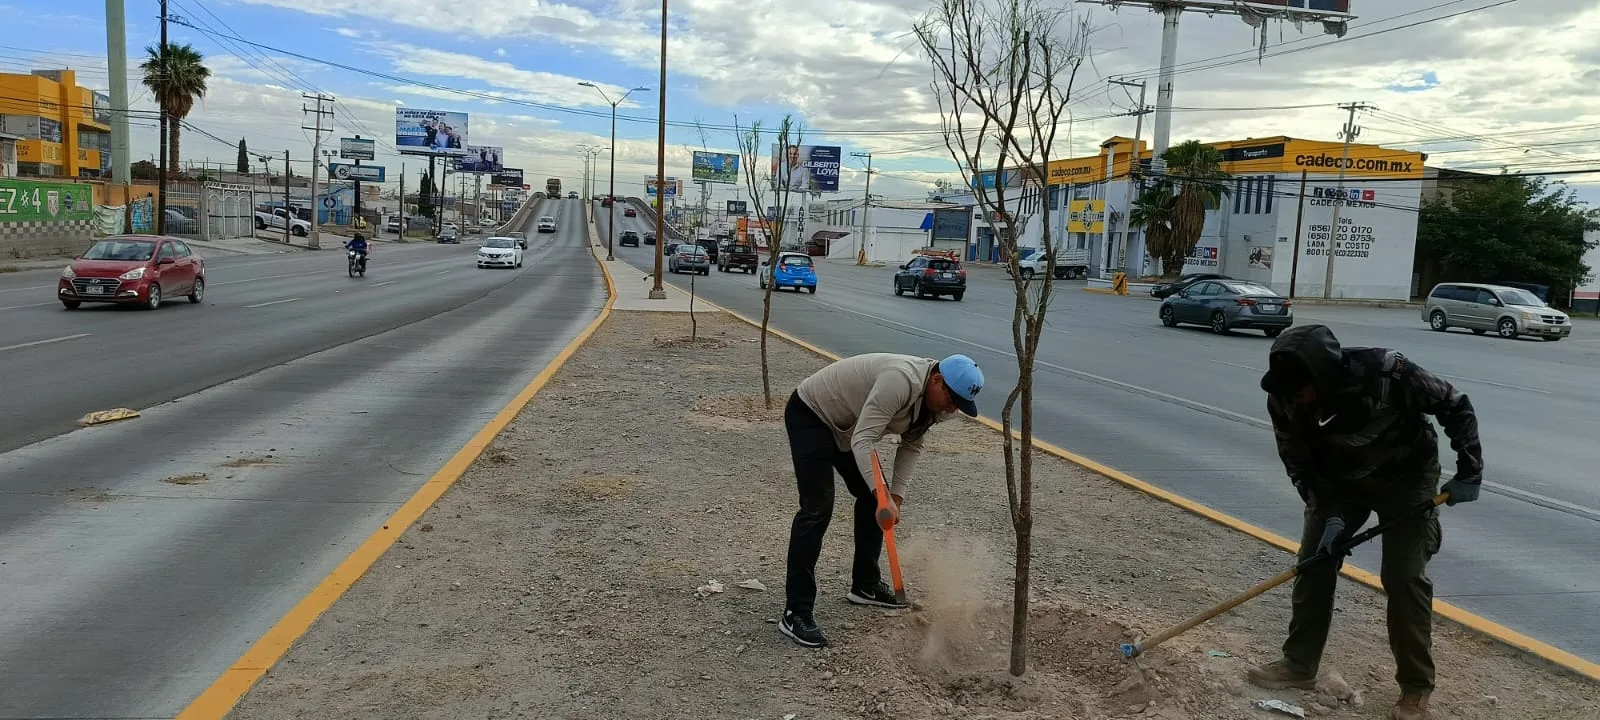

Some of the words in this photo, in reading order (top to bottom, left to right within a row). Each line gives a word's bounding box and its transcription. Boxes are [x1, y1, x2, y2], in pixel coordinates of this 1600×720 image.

[802, 160, 839, 169] GILBERTO
[1295, 153, 1412, 172] cadeco.com.mx
[816, 168, 838, 176] LOYA
[1351, 226, 1373, 234] 0170
[1350, 234, 1371, 242] 8753
